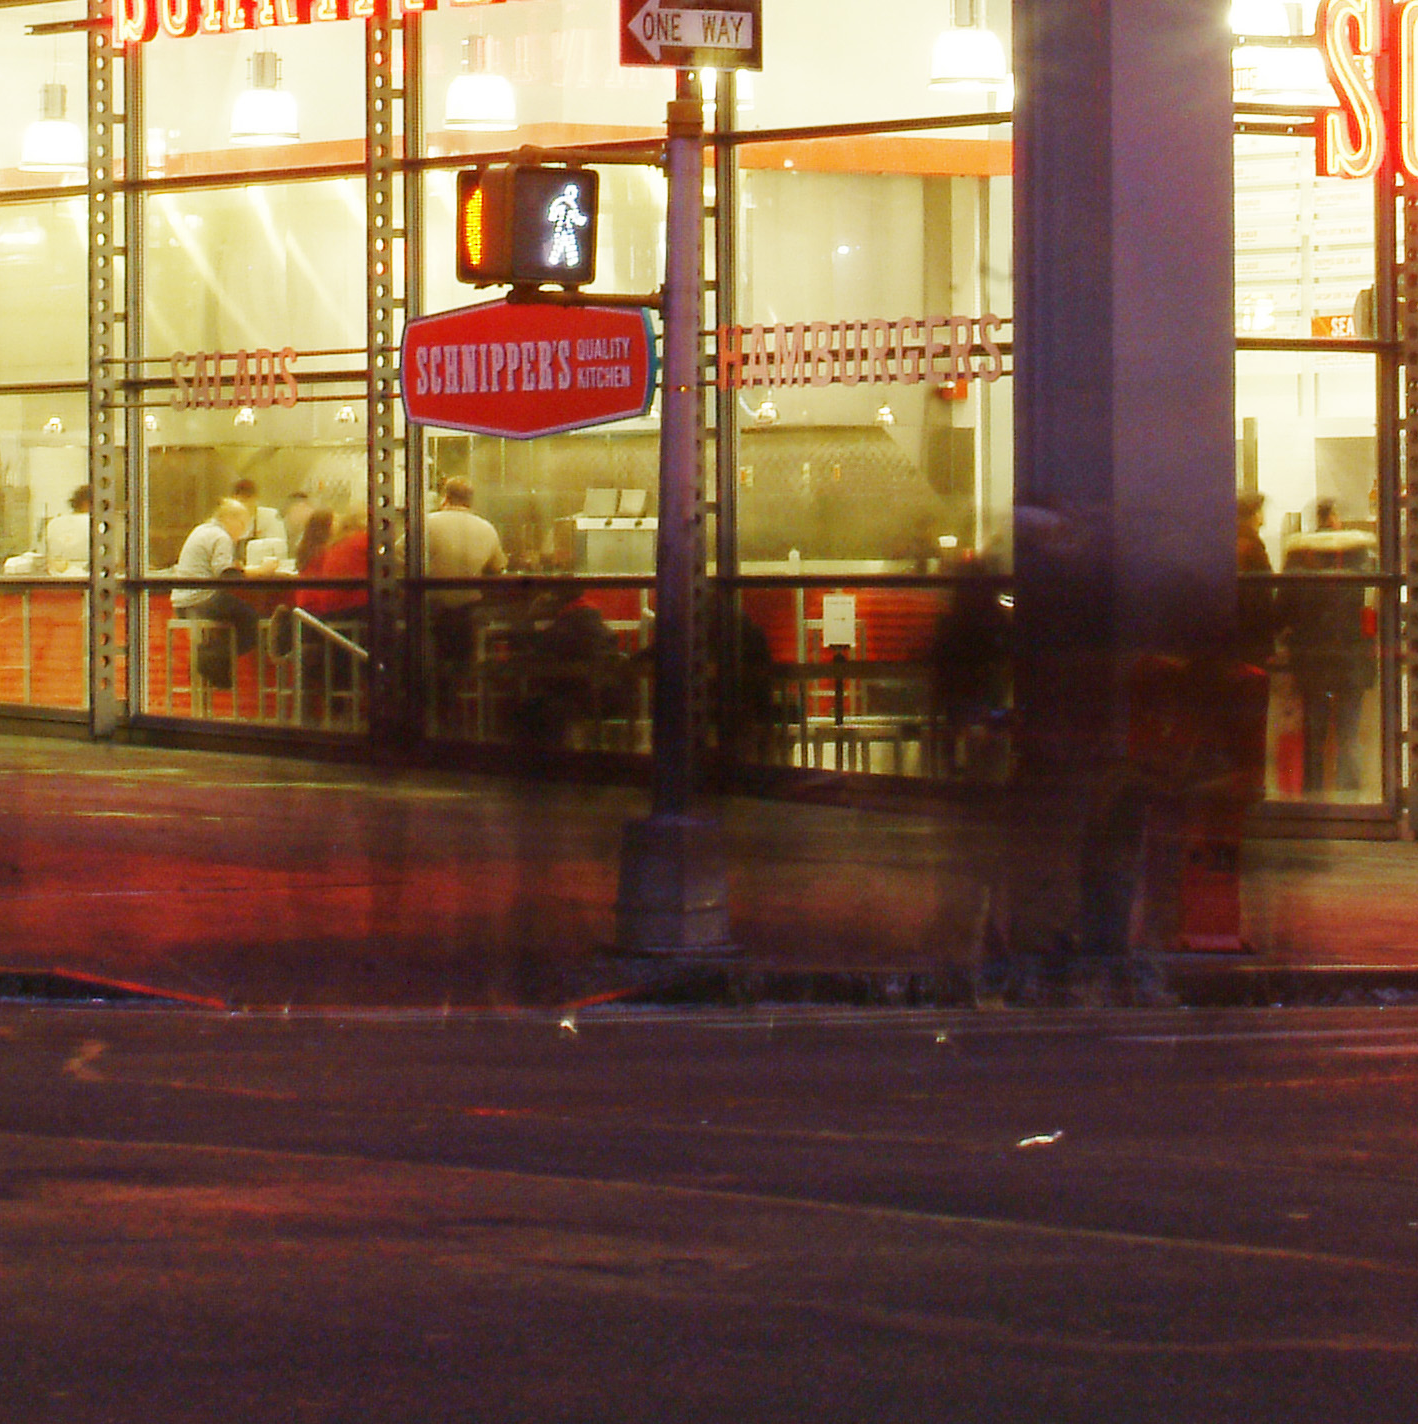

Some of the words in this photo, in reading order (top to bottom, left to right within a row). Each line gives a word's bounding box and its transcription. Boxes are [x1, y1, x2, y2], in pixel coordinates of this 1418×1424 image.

[642, 12, 682, 42] ONE
[701, 15, 743, 43] WAY
[416, 339, 571, 396] SCHNIPPER'S
[577, 337, 631, 361] QUALITY
[717, 313, 1003, 392] HAMBURGERS
[170, 346, 298, 412] SALADS
[577, 365, 631, 389] KITCHEN
